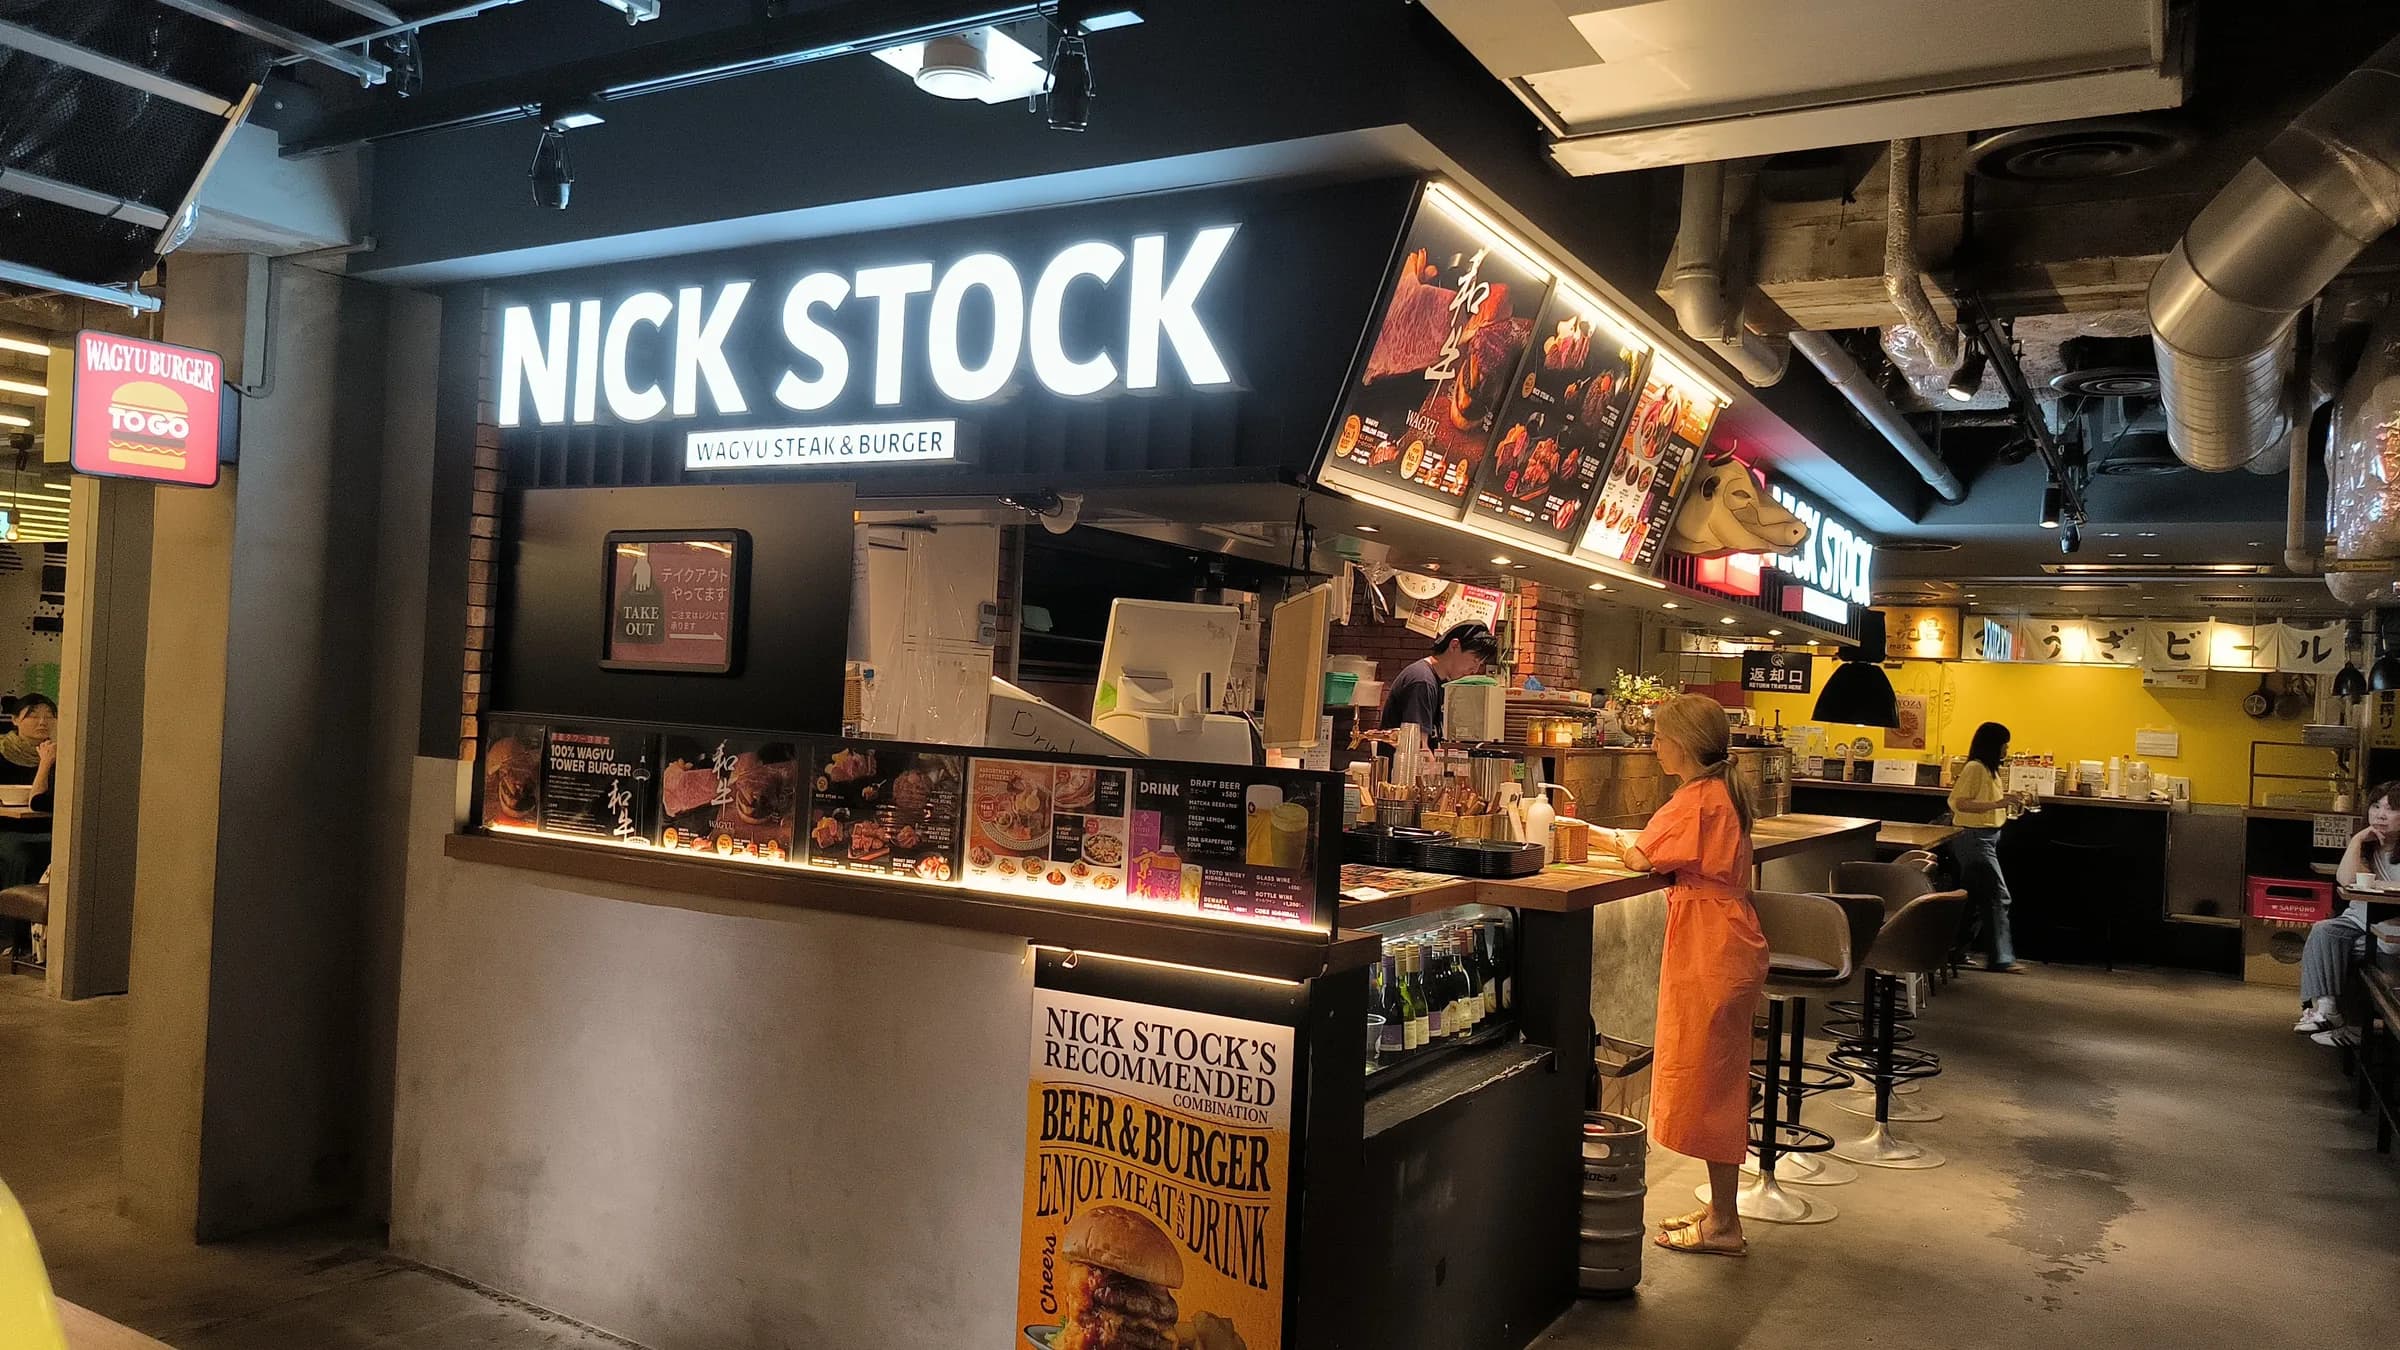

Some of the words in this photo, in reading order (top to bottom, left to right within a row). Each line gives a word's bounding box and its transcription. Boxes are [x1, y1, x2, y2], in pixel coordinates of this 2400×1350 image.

[498, 281, 753, 427] NICK
[774, 224, 1238, 412] STOCK
[86, 338, 147, 372] WAGYU
[148, 350, 214, 393] BURGER
[108, 406, 146, 432] TO
[147, 413, 189, 439] GO
[1406, 410, 1439, 435] WAGYU
[697, 440, 767, 461] WAGYU
[774, 436, 834, 458] STEAK
[840, 435, 853, 455] &
[859, 431, 942, 455] BURGER
[1820, 517, 1873, 607] STOCK
[661, 568, 729, 582] テイクアウト
[671, 586, 728, 602] やってます
[623, 606, 659, 620] TAKE
[625, 622, 655, 636] OUT
[1749, 667, 1803, 683] 返却口
[550, 744, 575, 759] 100%
[577, 747, 615, 762] WAGYU
[550, 757, 585, 773] TOWER
[587, 761, 632, 777] BURGER
[710, 738, 738, 820] 和牛
[1140, 780, 1180, 797] DRINK
[1190, 778, 1217, 789] DRAFT
[1219, 781, 1241, 790] BEER
[607, 778, 635, 843] 和牛
[1189, 799, 1211, 807] MATCHA
[1205, 869, 1224, 877] KYOTO
[1256, 874, 1275, 882] GLASS
[1255, 891, 1277, 899] BOTTLE
[2279, 904, 2316, 913] SAPPORO
[1045, 1006, 1124, 1050] NICK
[1133, 1021, 1277, 1076] STOCK'S
[1044, 1040, 1276, 1107] RECOMMENDED
[1173, 1093, 1268, 1124] COMBINATION
[1039, 1088, 1116, 1152] BEER
[1119, 1104, 1140, 1160] &
[1142, 1109, 1272, 1192] BURGER
[1036, 1153, 1109, 1225] ENJOY
[1111, 1166, 1178, 1230] MEAT
[1176, 1191, 1186, 1241] AND
[1187, 1193, 1271, 1291] DRINK
[1040, 1233, 1058, 1315] Cheers
